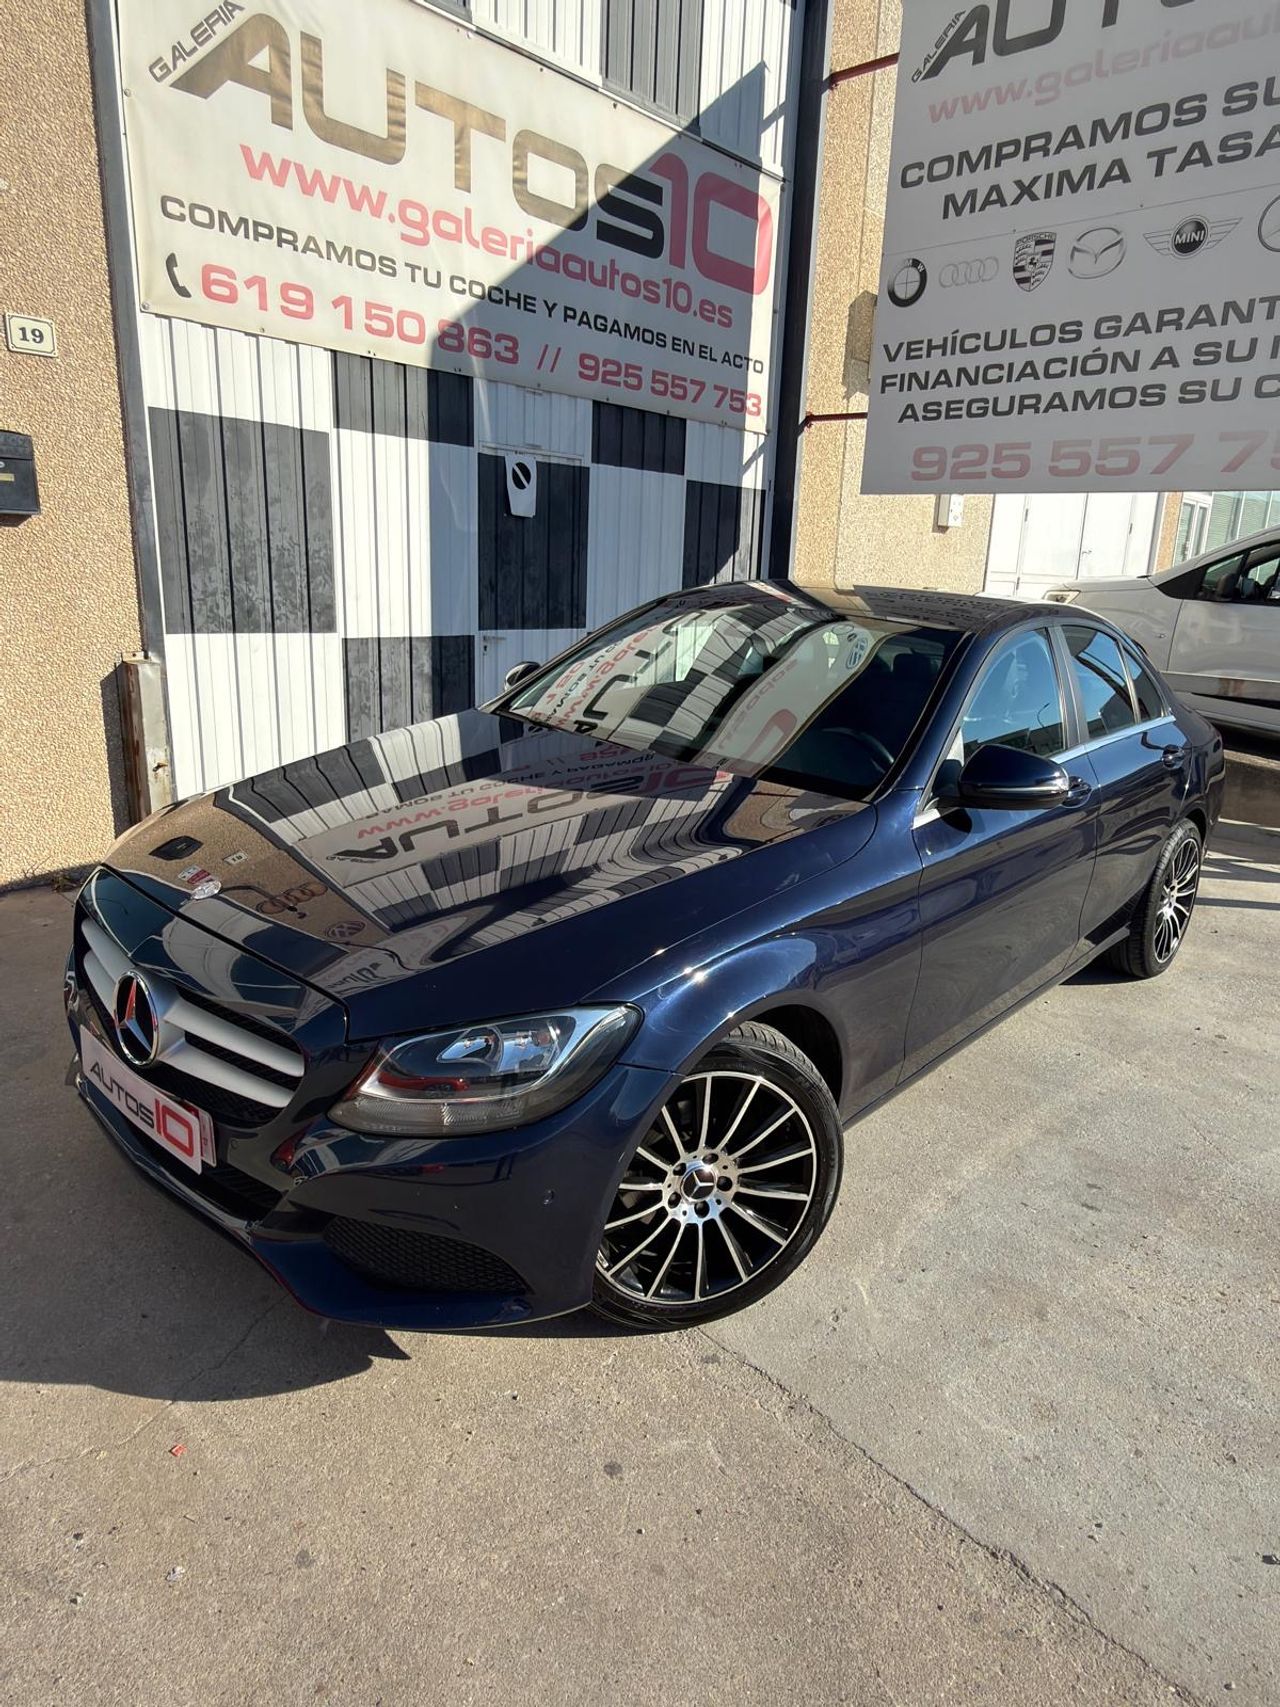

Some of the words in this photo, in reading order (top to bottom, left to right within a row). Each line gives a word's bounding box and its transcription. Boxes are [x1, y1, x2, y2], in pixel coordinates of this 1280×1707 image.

[148, 0, 246, 84] GALERIA
[911, 10, 967, 84] GALERIA
[169, 13, 773, 296] AUTOS10
[901, 93, 1207, 189] COMPRAMOS
[942, 158, 1131, 219] MAXIMA
[239, 143, 733, 329] www.galeriaautos10.es
[1174, 230, 1205, 245] MINI
[160, 195, 397, 278] COMPRAMOS
[404, 262, 441, 289] TU
[449, 275, 537, 314] COCHE
[542, 299, 558, 318] Y
[563, 307, 667, 348] PAGAMOS
[671, 337, 696, 359] EN
[698, 346, 718, 363] EL
[721, 356, 765, 375] ACTO
[19, 326, 44, 344] 19
[201, 263, 315, 320] 619
[331, 295, 426, 345] 150
[437, 319, 520, 366] 863
[578, 353, 643, 391] 925
[650, 370, 706, 404] 557
[713, 385, 762, 417] 753
[880, 347, 1140, 394] FINANCIACIÓN
[1150, 346, 1180, 371] A
[1193, 337, 1258, 366] SU
[883, 320, 1083, 362] VEHÍCULOS
[1094, 295, 1280, 341] GARANT
[898, 383, 1166, 423] ASEGURAMOS
[1178, 377, 1242, 404] SU
[911, 442, 1032, 481] 925
[1048, 434, 1195, 477] 557
[90, 1061, 194, 1158] AUTOS10
